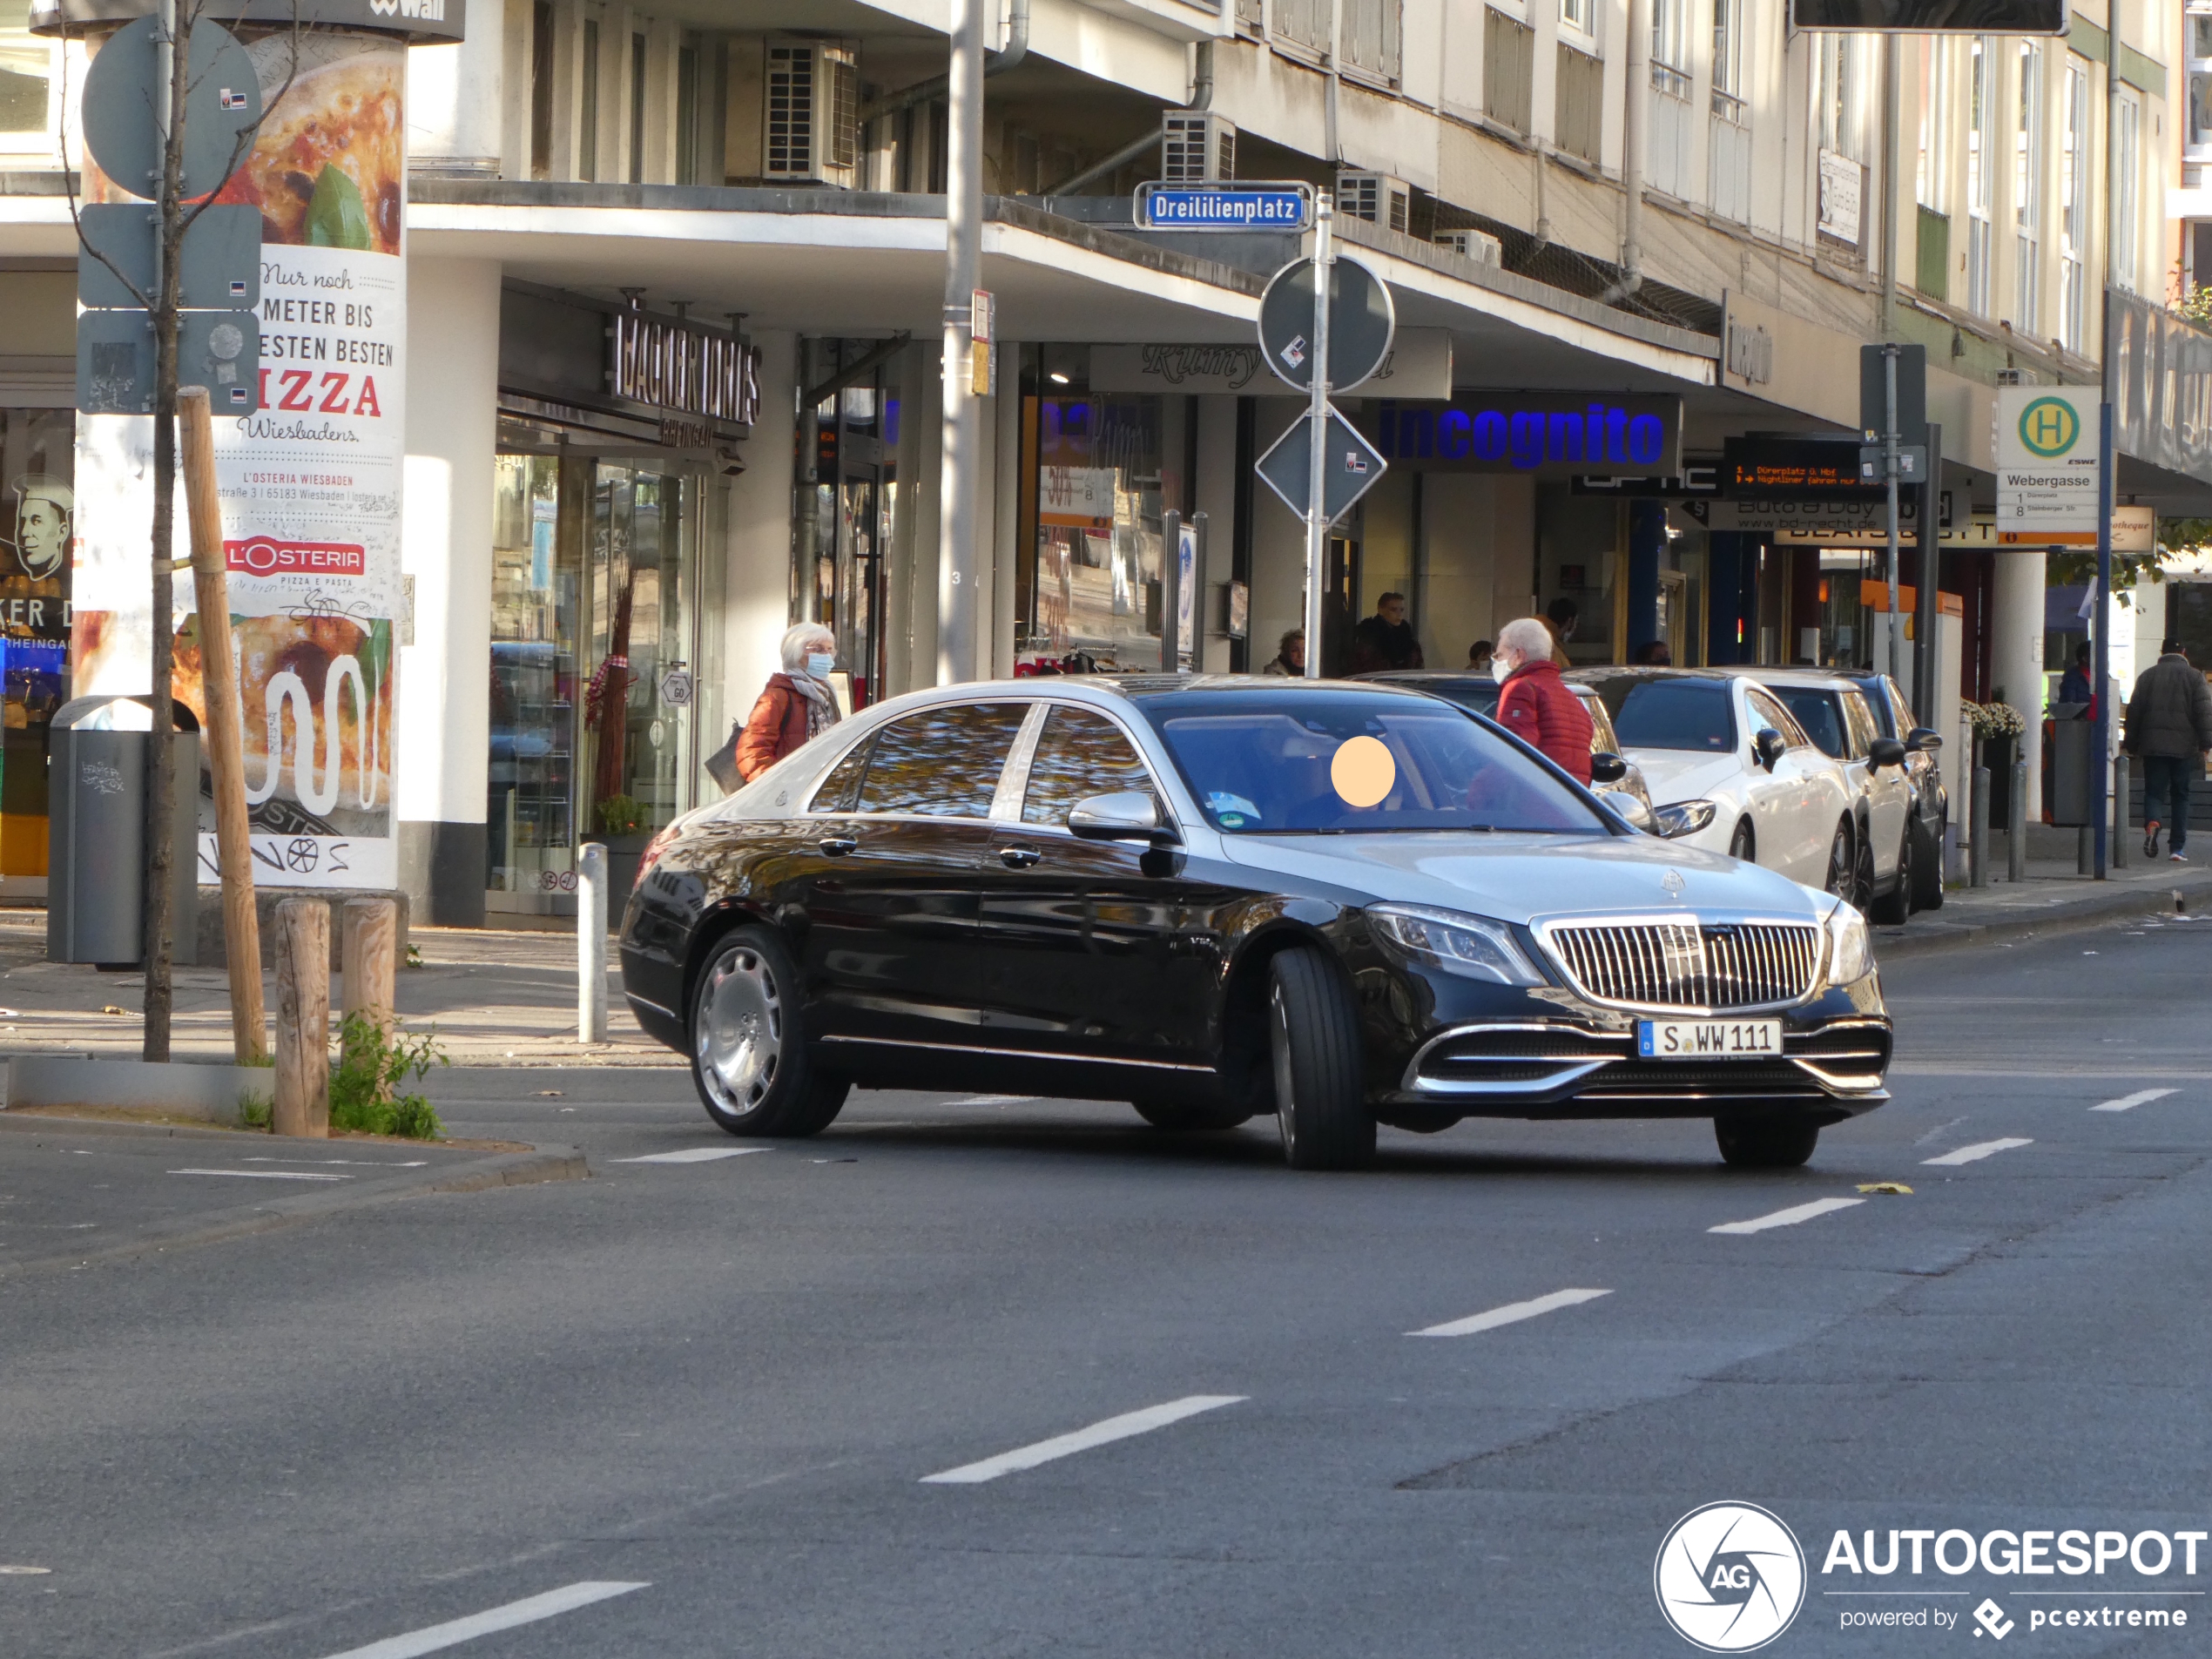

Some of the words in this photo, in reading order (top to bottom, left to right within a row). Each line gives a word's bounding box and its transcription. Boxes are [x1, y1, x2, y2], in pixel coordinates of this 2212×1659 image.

[1156, 196, 1295, 224] Dreililienplatz
[261, 262, 308, 287] Nur
[314, 268, 354, 290] noch
[263, 298, 335, 325] METER
[345, 303, 373, 328] BIS
[259, 334, 327, 361] ESTEN
[336, 339, 394, 368] BESTEN
[258, 368, 381, 418] IZZA
[1379, 399, 1664, 470] incognito
[243, 472, 297, 485] L'OSTERIA
[300, 475, 354, 486] WIESBADEN
[2006, 474, 2090, 489] Webergasse
[217, 488, 248, 499] straße
[251, 489, 257, 498] 3
[266, 489, 297, 500] 65183
[299, 489, 345, 502] Wiesbaden
[2016, 493, 2023, 504] 1
[2016, 506, 2025, 517] 8
[2111, 521, 2149, 532] otheque
[229, 543, 361, 569] L'OSTERIA
[280, 577, 310, 586] PIZZA
[325, 578, 353, 588] PASTA
[1663, 1026, 1679, 1052] S
[1695, 1025, 1725, 1052] WW
[1730, 1024, 1771, 1052] 111
